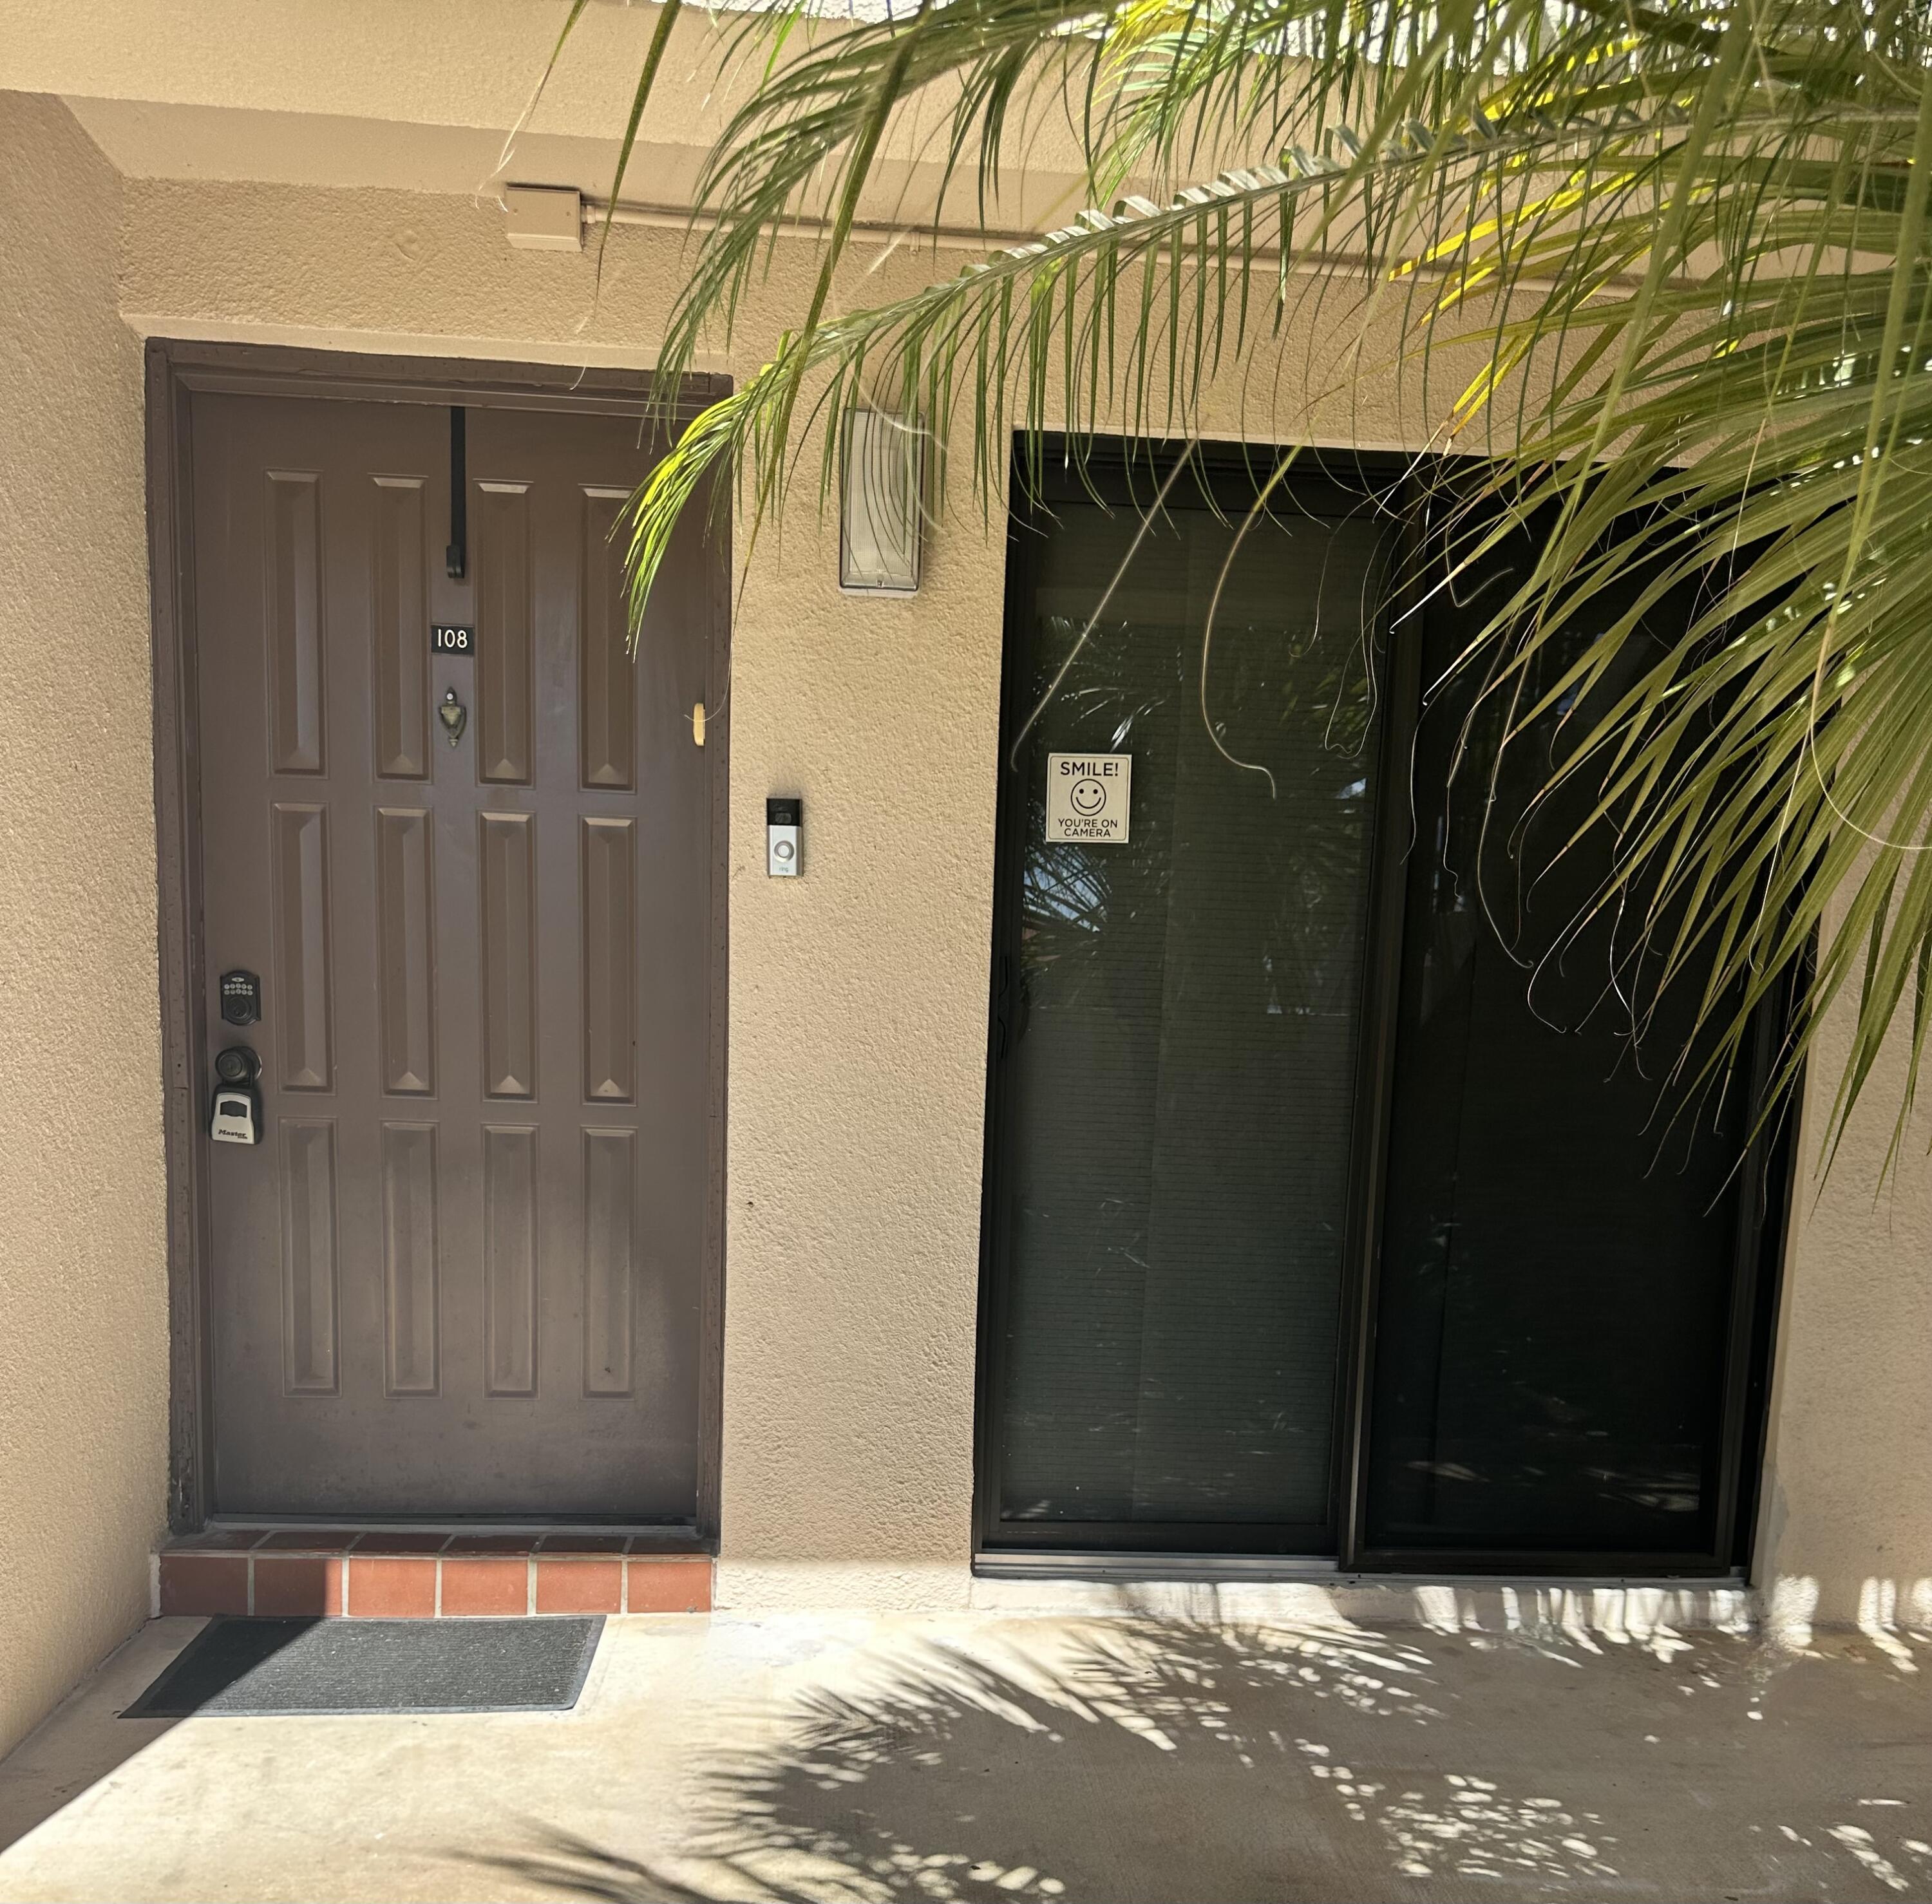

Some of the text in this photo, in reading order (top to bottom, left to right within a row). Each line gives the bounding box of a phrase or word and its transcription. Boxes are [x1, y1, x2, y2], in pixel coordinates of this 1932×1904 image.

[438, 628, 468, 648] 108
[1060, 762, 1119, 777] SMILE!
[1058, 818, 1118, 828] YOU'RE ON
[1064, 828, 1111, 837] CAMERA
